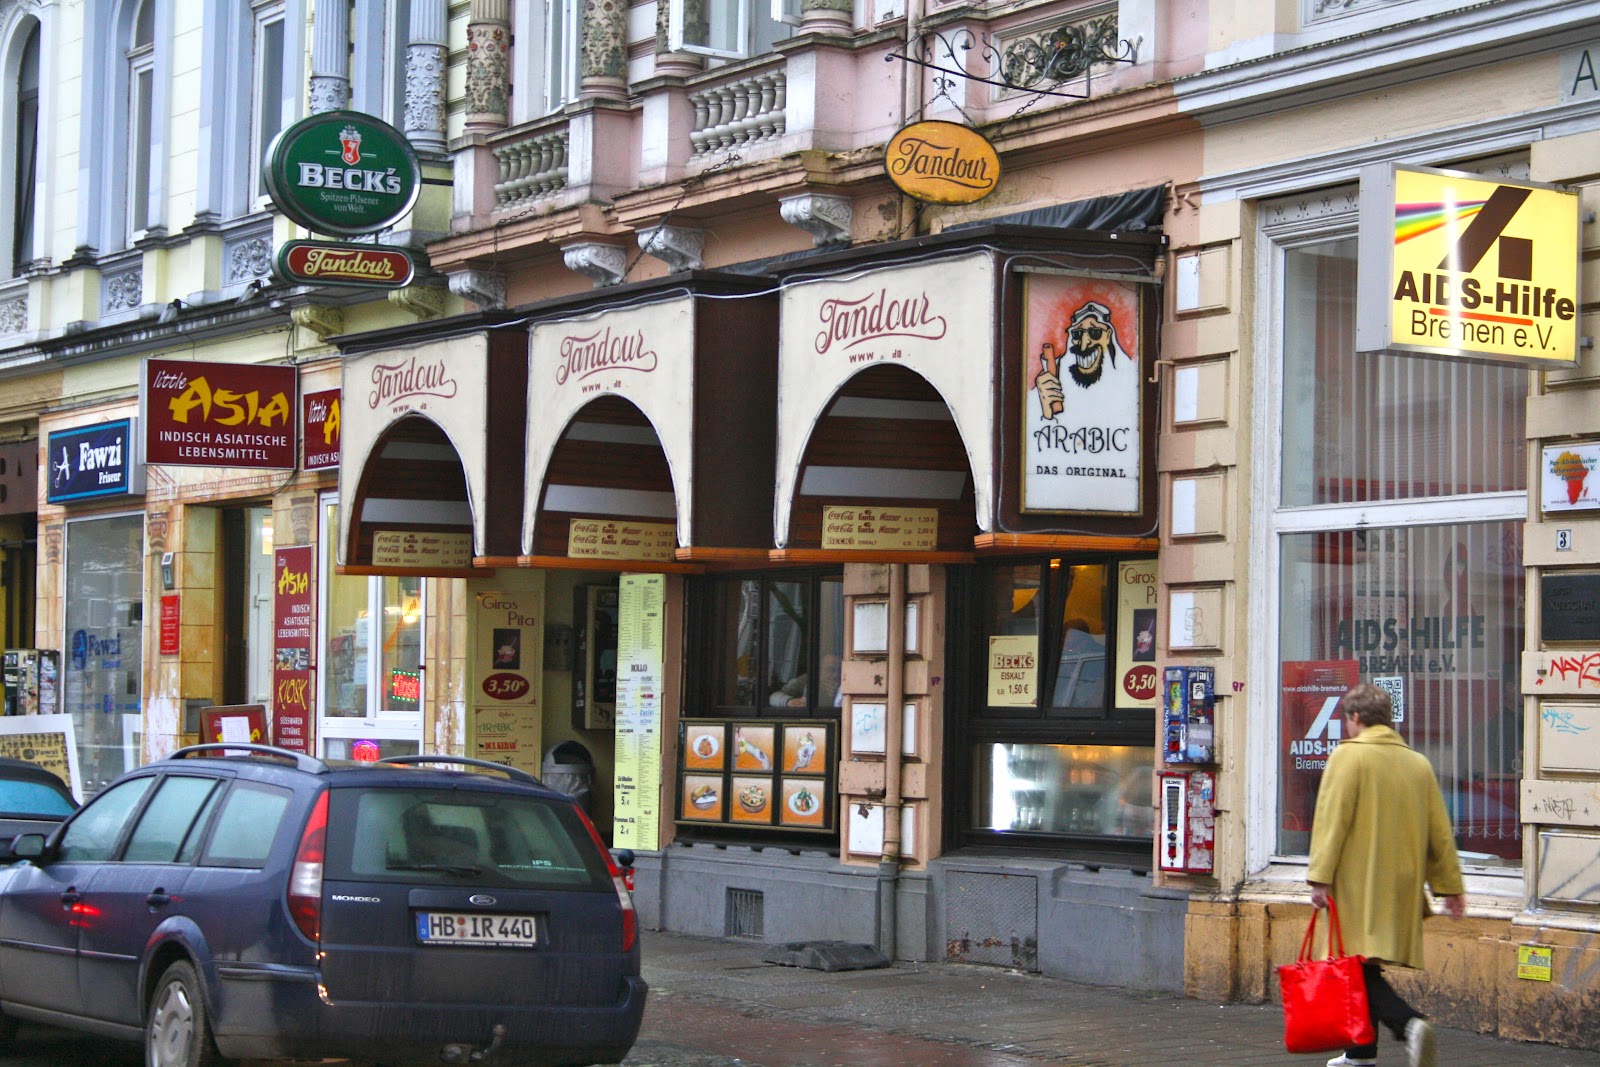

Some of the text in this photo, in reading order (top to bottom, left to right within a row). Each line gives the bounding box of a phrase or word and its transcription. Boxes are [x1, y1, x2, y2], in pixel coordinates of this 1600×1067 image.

[892, 138, 993, 188] Tandour
[320, 192, 379, 206] Spitzen-Pilsener
[334, 204, 347, 212] von
[304, 249, 394, 279] Tandour
[1394, 270, 1575, 320] AIDS-Hilfe
[814, 288, 947, 354] Tandour
[1412, 310, 1556, 351] Bremen e.V.
[556, 326, 658, 386] Tandour
[152, 370, 187, 390] little
[368, 356, 457, 410] Tandour
[168, 376, 289, 428] ASIA
[160, 430, 287, 447] INDISCH ASIATISCHE
[1033, 425, 1130, 454] ARABIC
[79, 437, 121, 472] Fawzi
[178, 446, 269, 460] LEBENSMITTEL
[308, 454, 329, 466] INDISCH
[98, 471, 121, 485] Friseur
[1036, 465, 1127, 478] DAS ORIGINAL
[1560, 532, 1567, 548] 3
[278, 566, 308, 595] ASIA
[1124, 568, 1155, 584] Giros
[482, 596, 518, 610] Giros
[507, 611, 535, 626] Pita
[1336, 615, 1485, 651] AIDS-HILFE
[1359, 654, 1456, 674] BREMEN e.V.
[1001, 672, 1025, 680] EISKALT
[1128, 674, 1156, 692] 3,50
[277, 679, 308, 710] KIOSK
[1009, 684, 1022, 695] 1,50
[1024, 684, 1029, 694] €
[332, 895, 380, 903] MONDEO
[430, 916, 455, 936] HB
[471, 917, 494, 937] IR
[498, 918, 533, 938] 440
